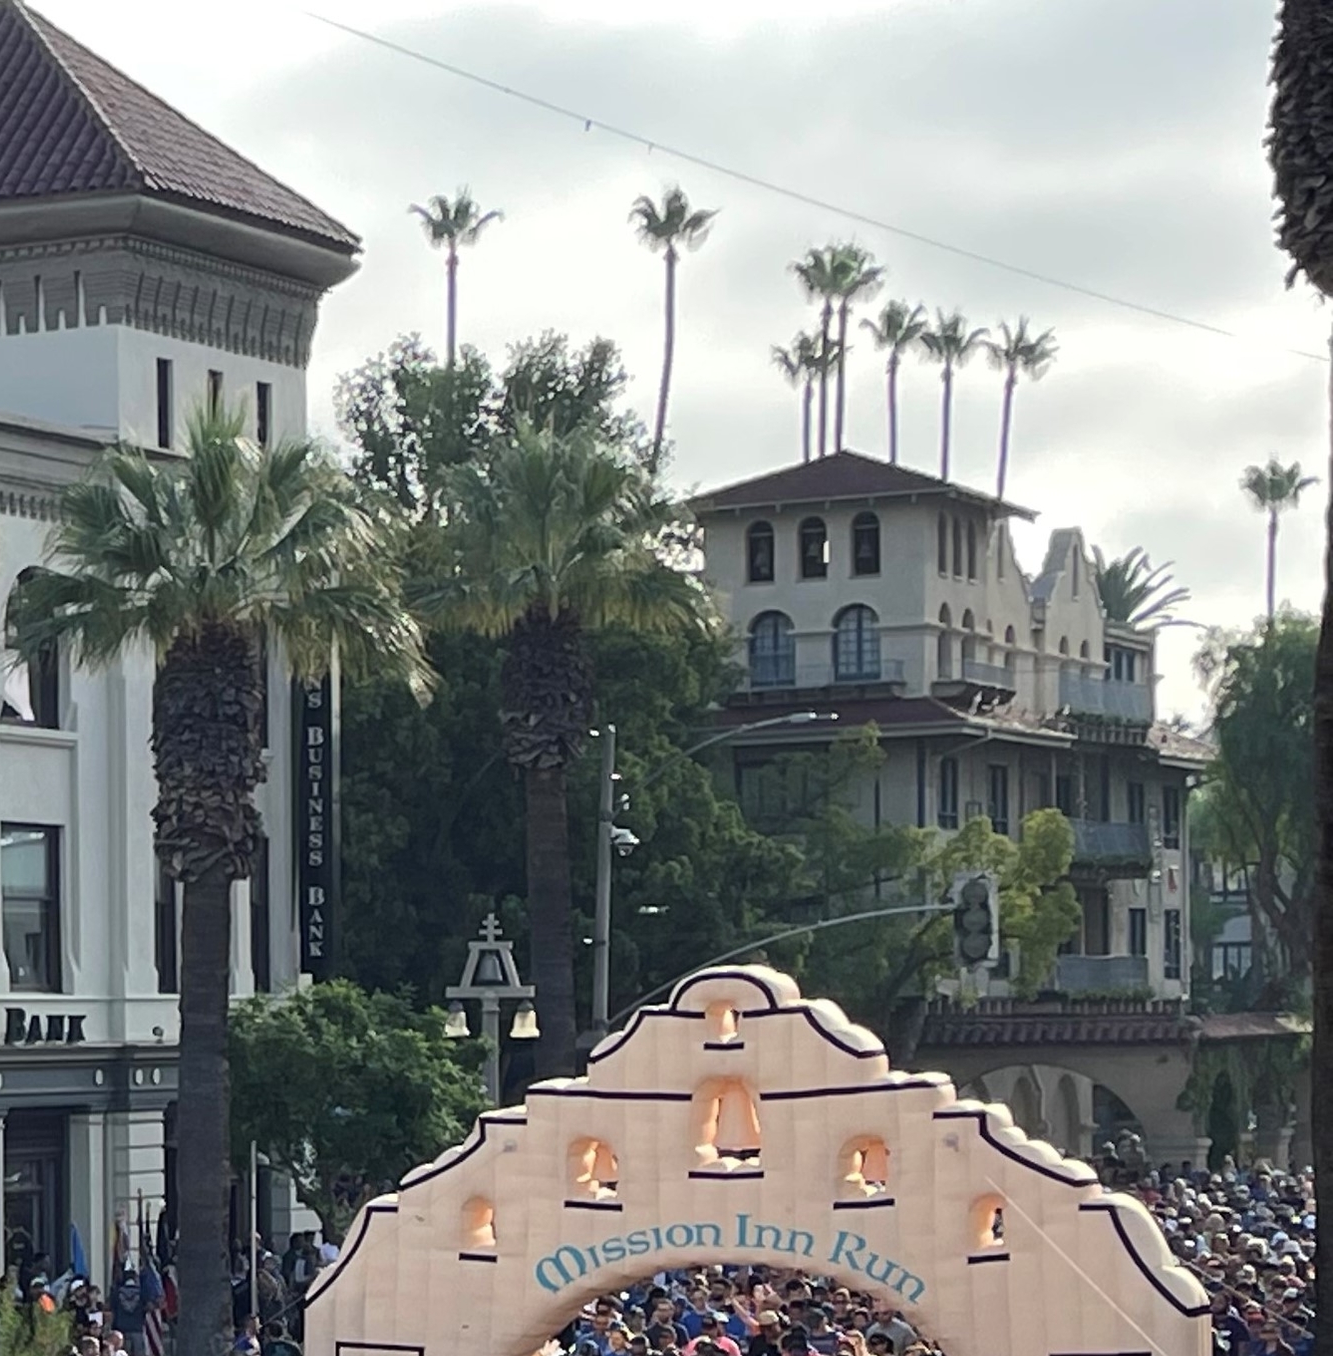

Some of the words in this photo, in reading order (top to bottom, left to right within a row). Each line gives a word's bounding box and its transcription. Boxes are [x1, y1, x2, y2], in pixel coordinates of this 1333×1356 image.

[307, 726, 324, 867] BUSINESS
[307, 886, 325, 958] BANK
[535, 1222, 723, 1294] Mission
[736, 1213, 814, 1257] Inn
[828, 1229, 926, 1304] Run
